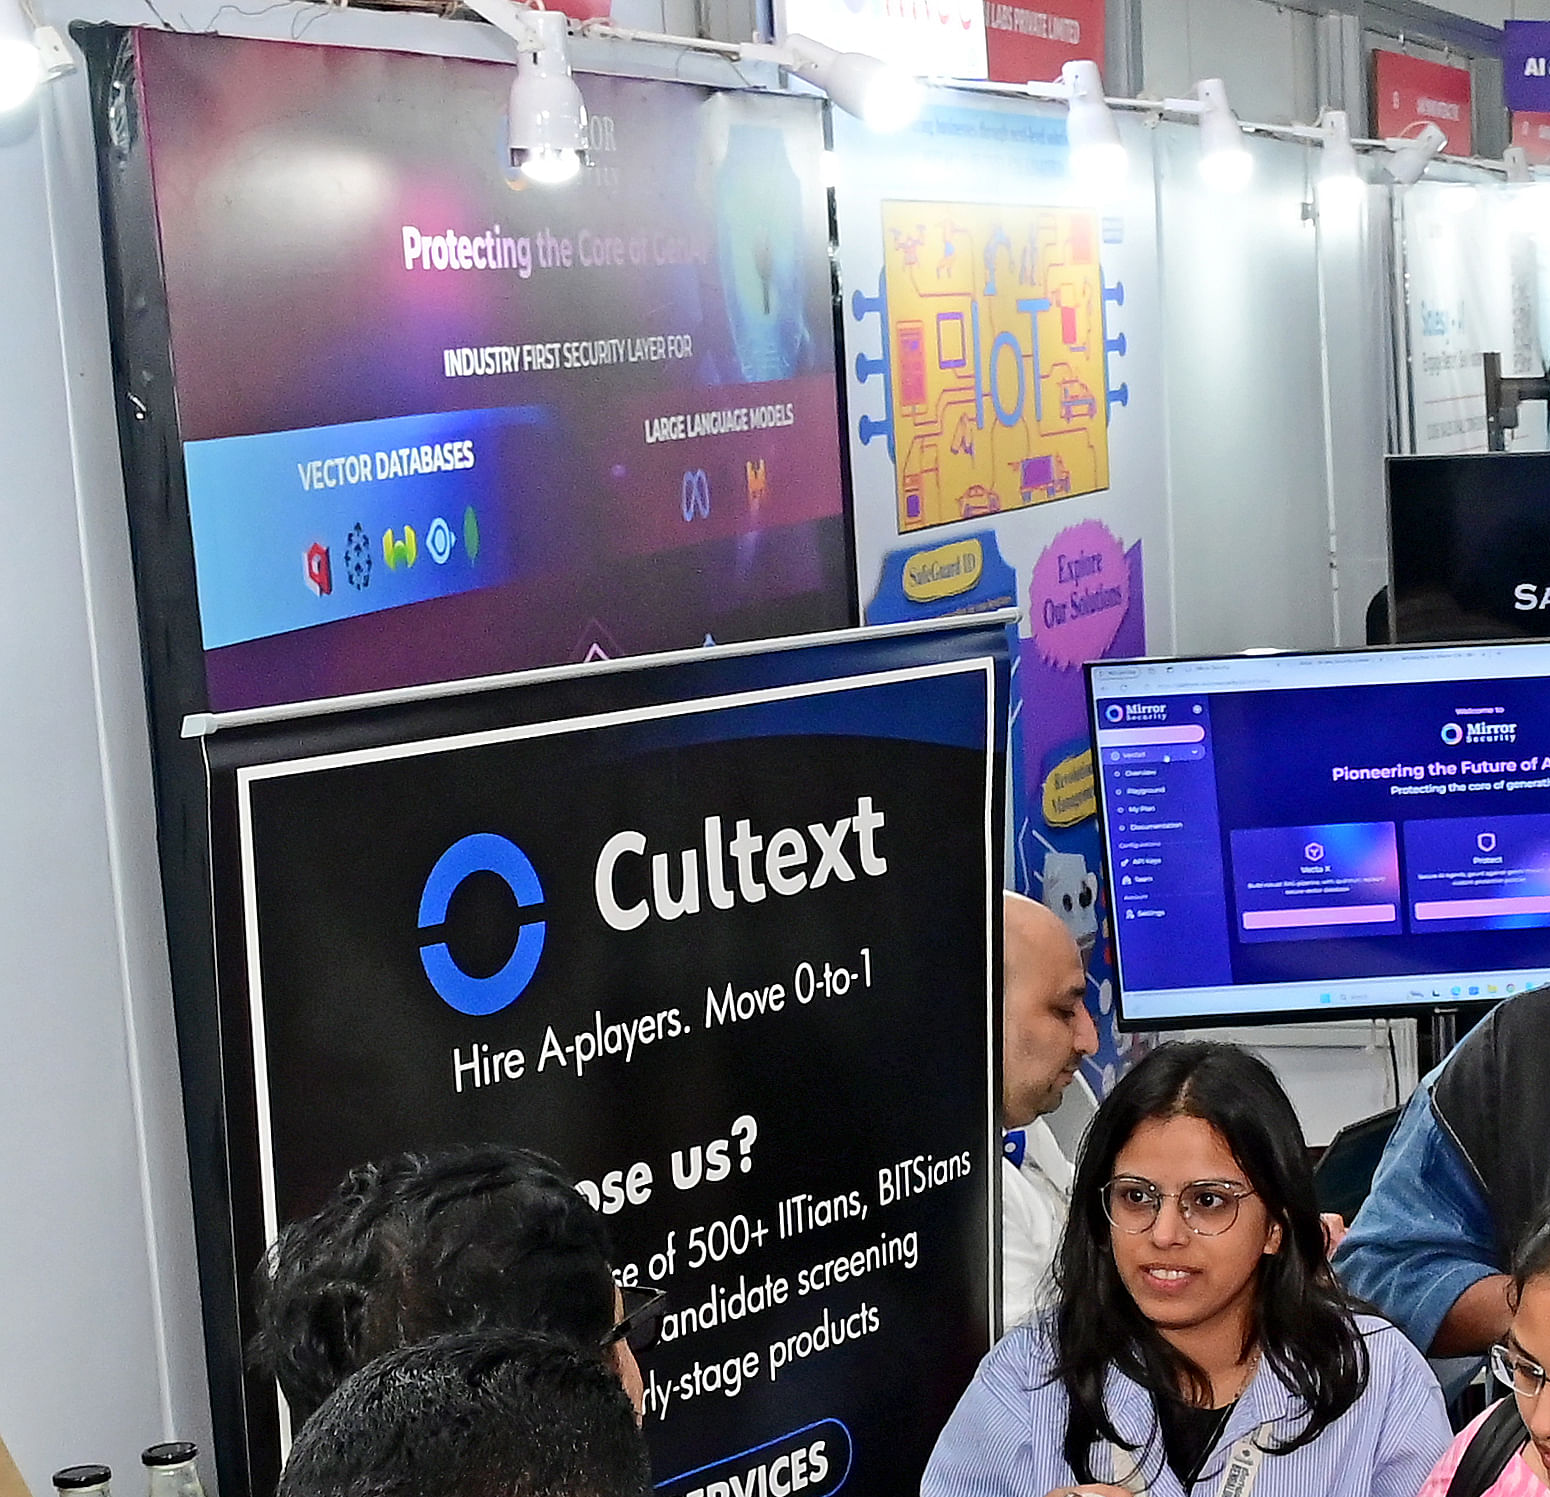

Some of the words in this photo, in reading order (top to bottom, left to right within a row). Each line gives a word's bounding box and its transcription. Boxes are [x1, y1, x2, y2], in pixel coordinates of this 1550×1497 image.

[1524, 57, 1545, 77] AI
[402, 225, 533, 279] Protecting
[535, 227, 574, 269] the
[444, 346, 521, 378] INDUSTRY
[522, 342, 562, 372] FIRST
[563, 338, 627, 369] SECURITY
[628, 335, 666, 362] LAYER
[667, 334, 693, 359] FOR
[644, 415, 686, 446] LARGE
[686, 408, 750, 439] LANGUAGE
[751, 402, 795, 430] MODELS
[297, 454, 374, 492] VECTOR
[375, 439, 476, 481] DATABASES
[1056, 550, 1104, 586] Explore
[1043, 598, 1070, 631] Our
[1070, 583, 1124, 622] Solutions
[1125, 704, 1167, 715] Mirror
[1466, 721, 1518, 736] Mirror
[1332, 763, 1426, 782] Pioneering
[1426, 761, 1458, 777] the
[1460, 757, 1518, 776] Future
[1519, 757, 1540, 772] of
[1390, 783, 1448, 797] Protecting
[1448, 781, 1468, 793] the
[1467, 780, 1493, 792] core
[1493, 779, 1506, 791] of
[595, 796, 889, 931] Cultext
[453, 1045, 526, 1093] Hire
[536, 1006, 691, 1078] A-players.
[704, 977, 786, 1031] Move
[795, 948, 875, 1006] 0-to-1
[575, 1160, 654, 1216] ose
[671, 1113, 759, 1192] us?
[648, 1230, 678, 1282] of
[687, 1213, 770, 1269] 500+
[778, 1189, 868, 1241] IITians,
[878, 1148, 973, 1208] BITSians
[657, 1275, 790, 1347] andidate
[797, 1231, 918, 1297] screening
[641, 1349, 761, 1420] rly-stage
[768, 1302, 881, 1384] products
